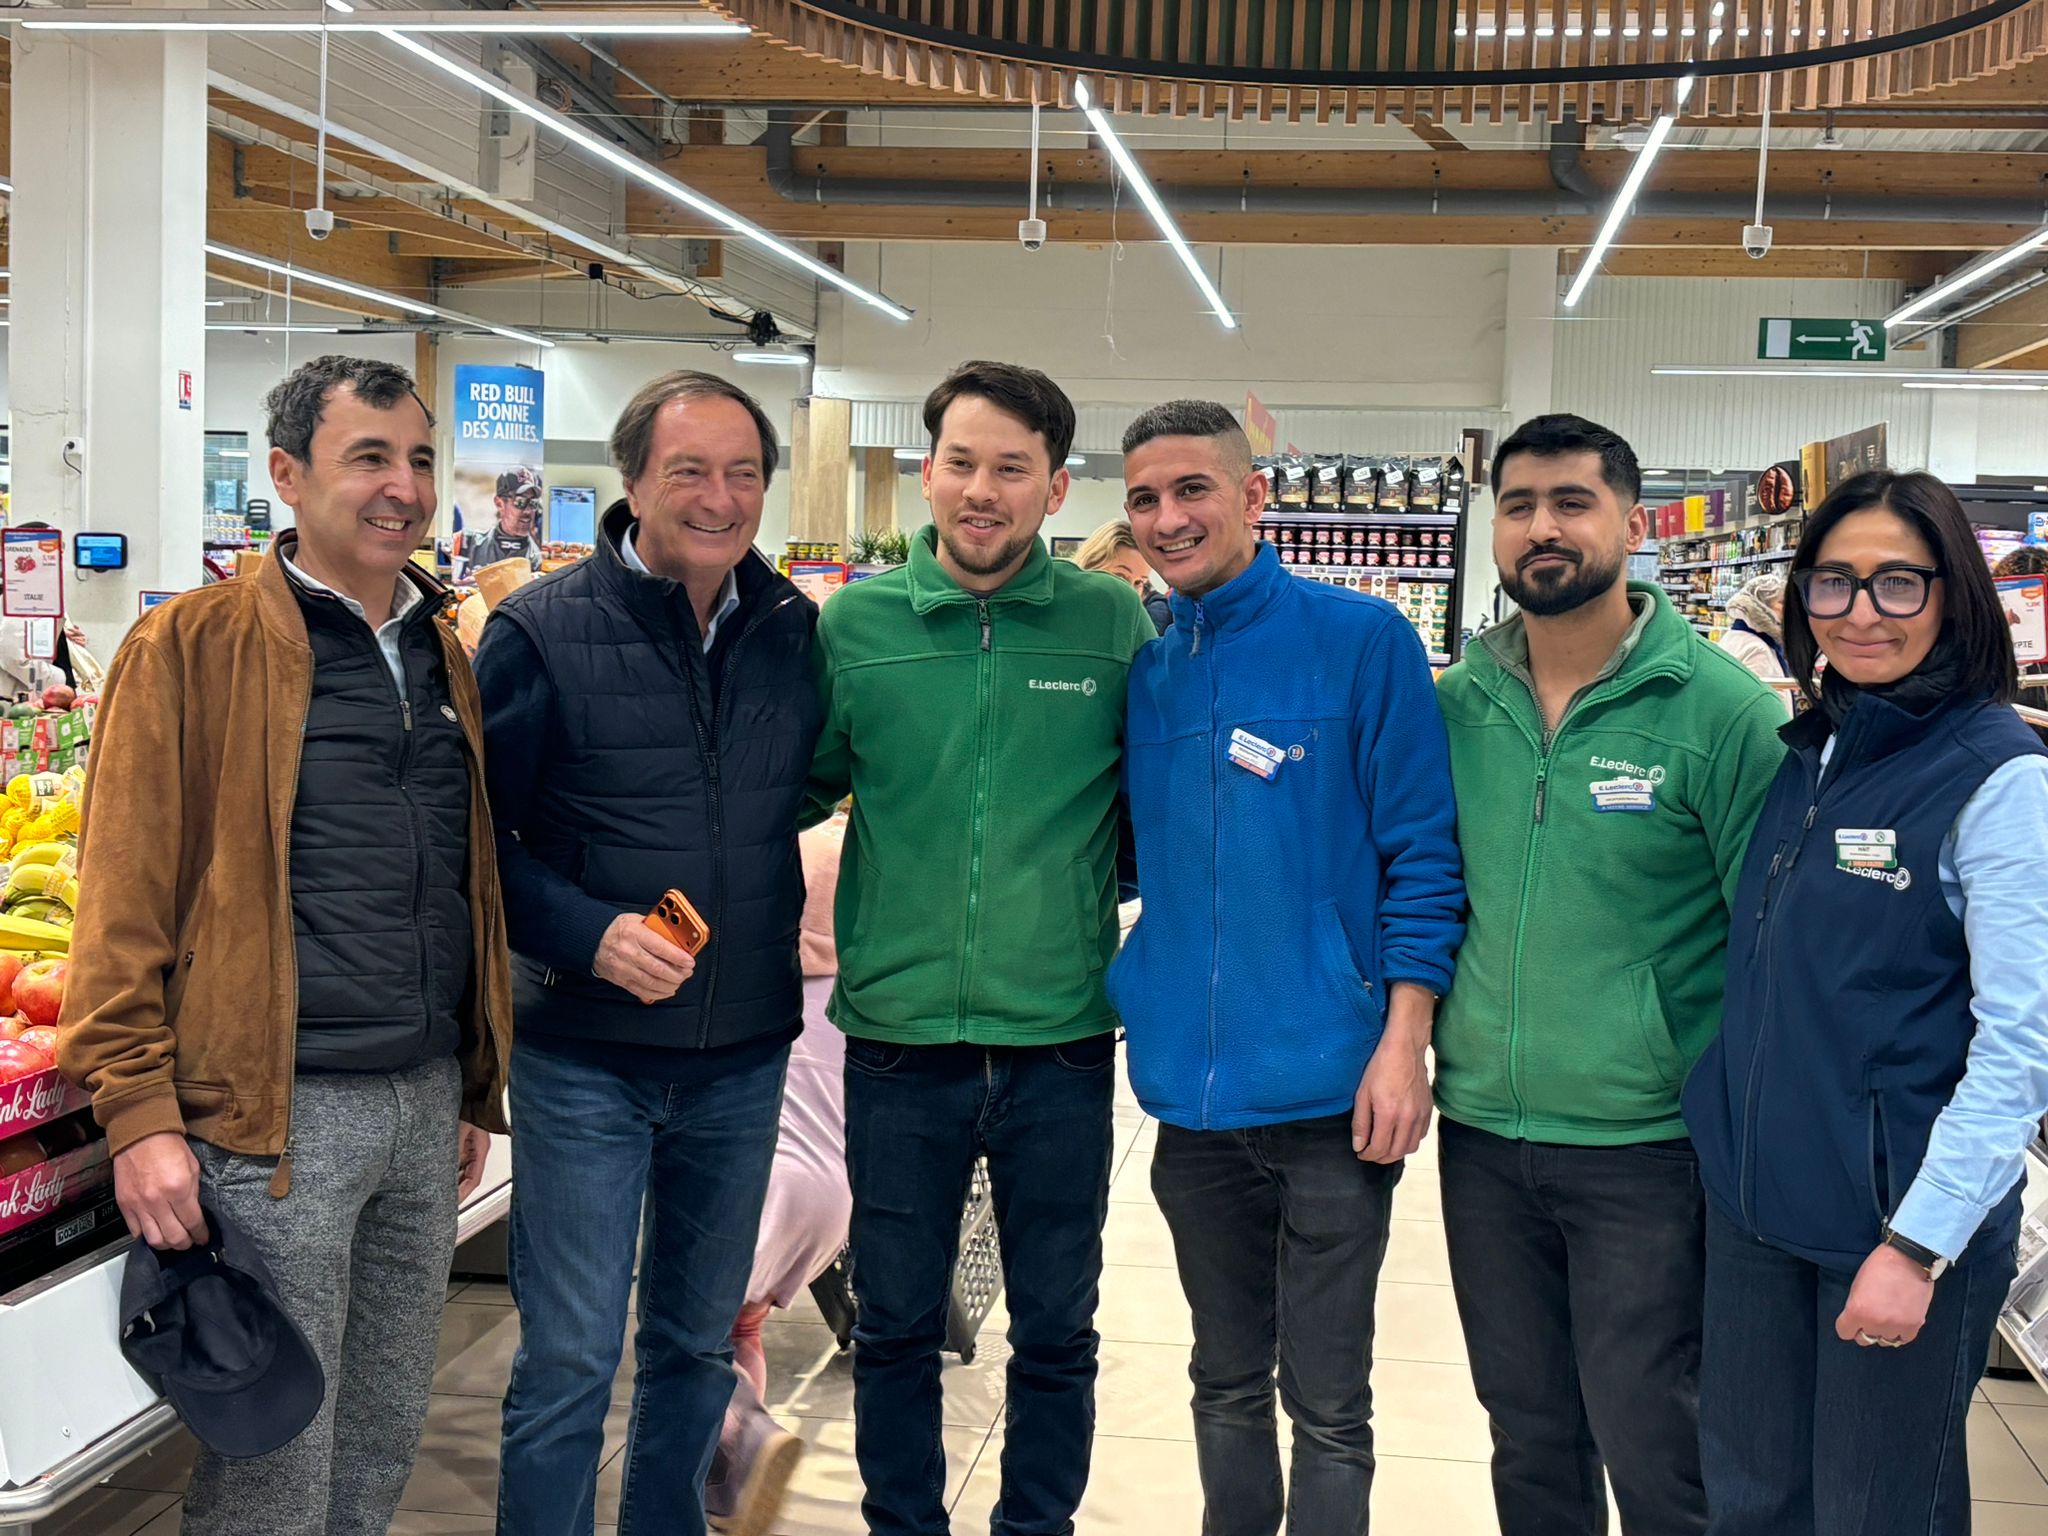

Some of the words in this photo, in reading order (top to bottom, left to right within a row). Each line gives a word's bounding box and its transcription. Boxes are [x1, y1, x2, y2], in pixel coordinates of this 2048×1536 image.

[470, 383, 500, 401] RED
[505, 385, 535, 405] BULL
[478, 402, 529, 422] DONNE
[463, 421, 490, 439] DES
[1028, 679, 1080, 691] E.Leclerc
[1590, 756, 1646, 777] E.Leclerc
[23, 1074, 66, 1120] Lady
[21, 1166, 65, 1214] Lady
